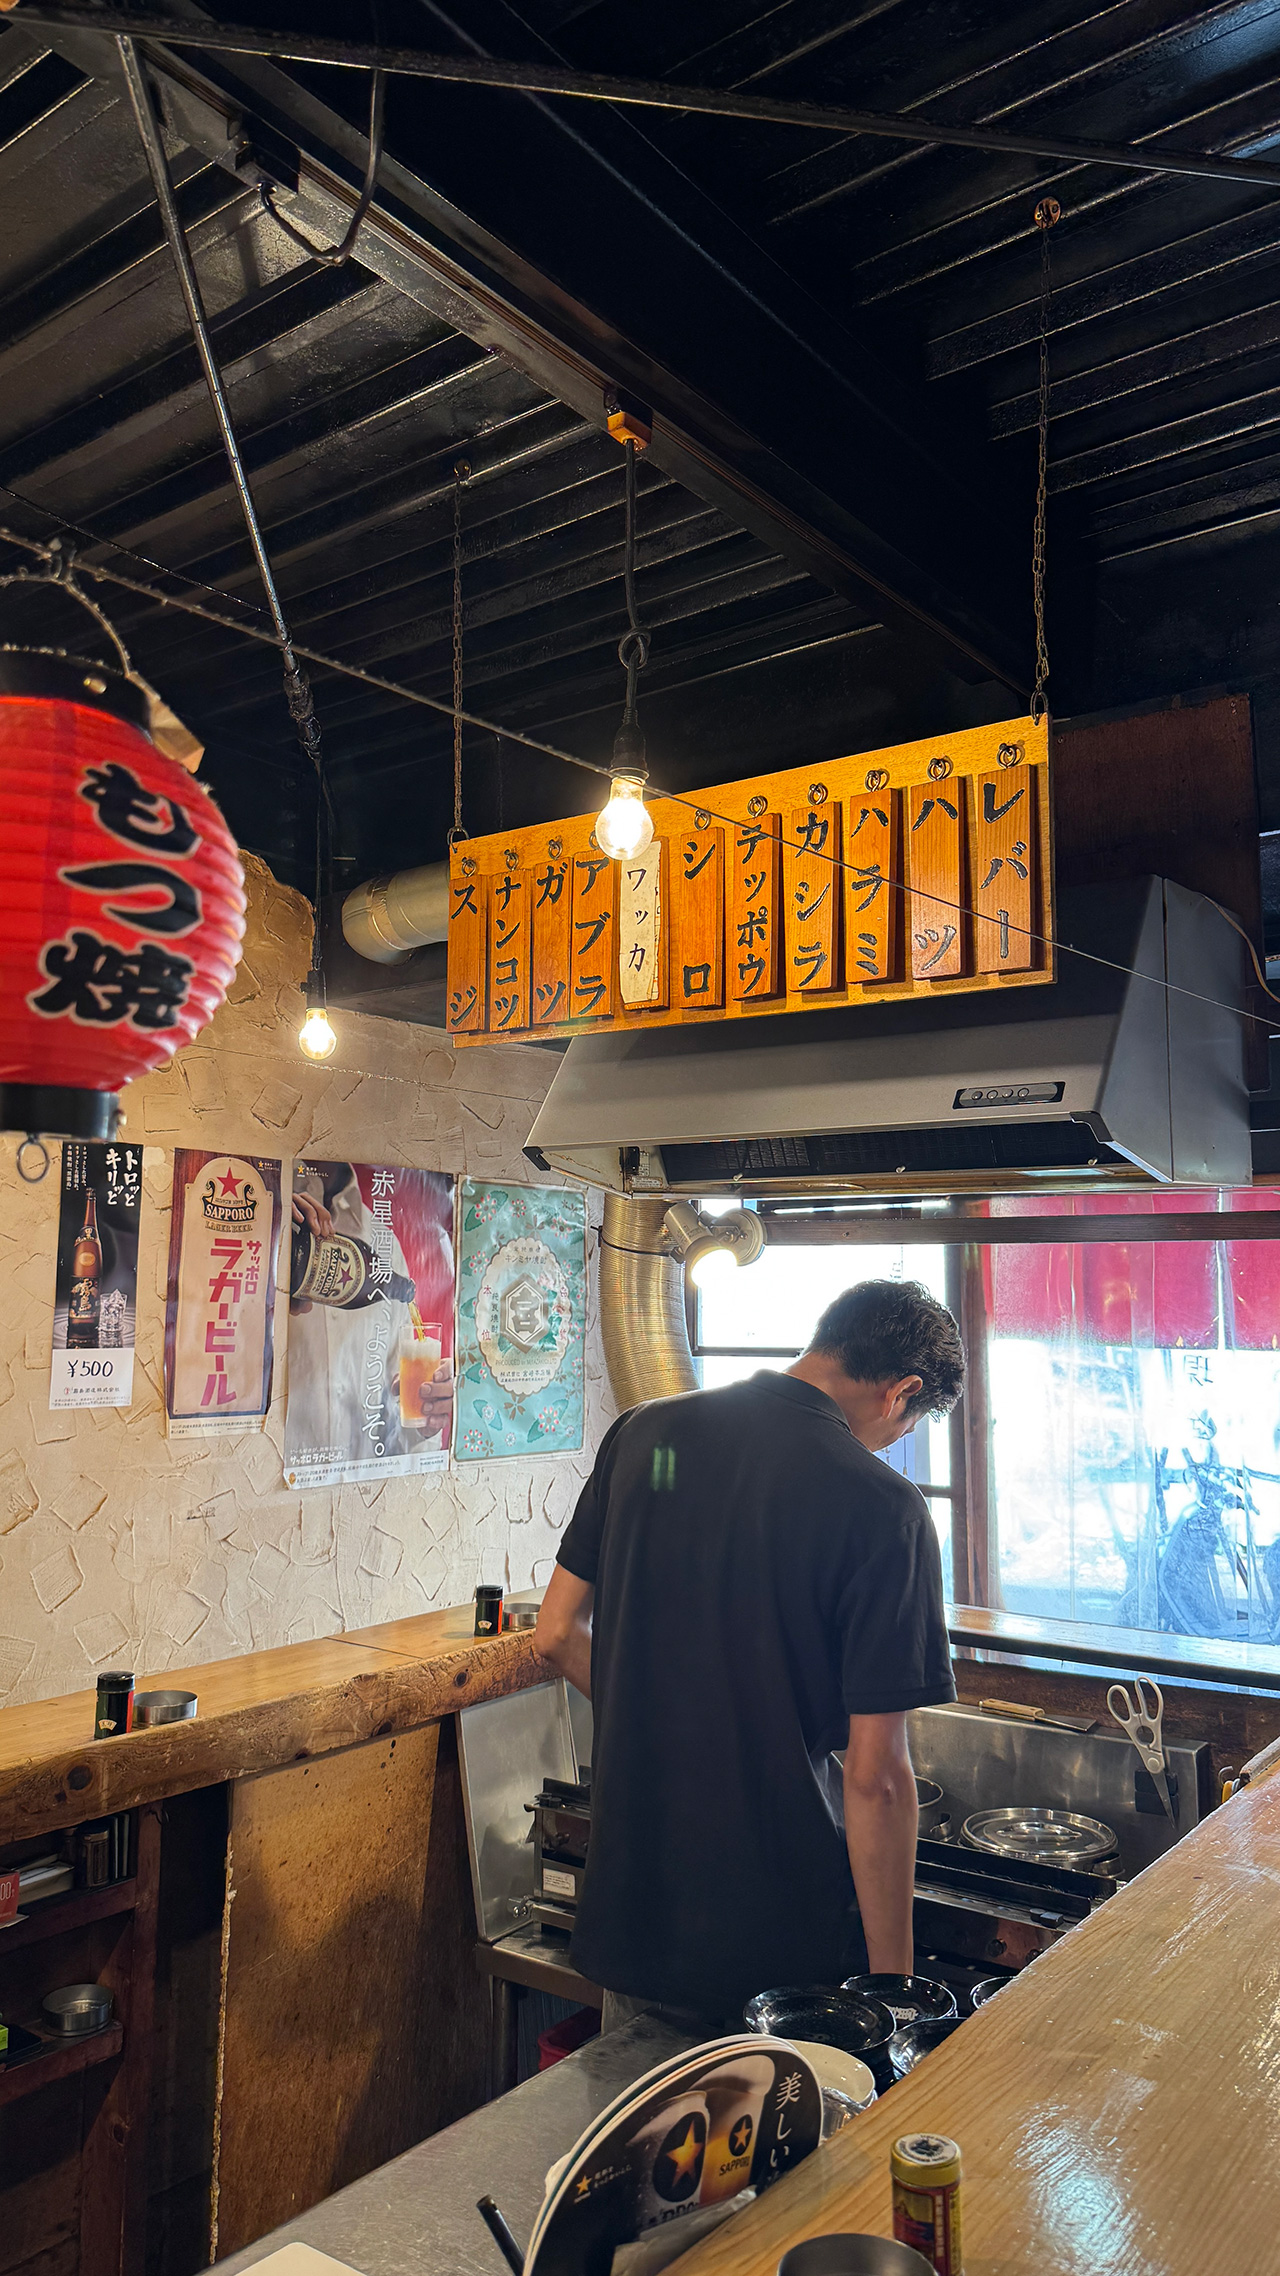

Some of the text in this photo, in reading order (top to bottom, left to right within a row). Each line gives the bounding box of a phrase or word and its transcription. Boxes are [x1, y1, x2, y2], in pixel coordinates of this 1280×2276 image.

[27, 762, 202, 1032] もつ焼
[535, 861, 569, 1015] ガツ
[573, 855, 609, 1016] アブラ
[627, 868, 649, 972] ワッカ
[682, 840, 717, 997] シロ
[735, 818, 768, 997] テッポウ
[793, 811, 830, 988] カシラ
[850, 806, 890, 978] ハラミ
[911, 797, 957, 972] ハツ
[980, 781, 1026, 960] レバー
[449, 886, 478, 1028] スジ
[105, 1148, 124, 1206] キリッと
[123, 1150, 140, 1207] トロッと
[205, 1204, 253, 1220] SAPPORO
[200, 1238, 244, 1406] ラガービール
[244, 1240, 262, 1295] サッポロ
[322, 1250, 339, 1294] SAPPORO
[361, 1170, 396, 1457] 赤星酒場へ、ようこそ。
[67, 1360, 113, 1378] ¥500
